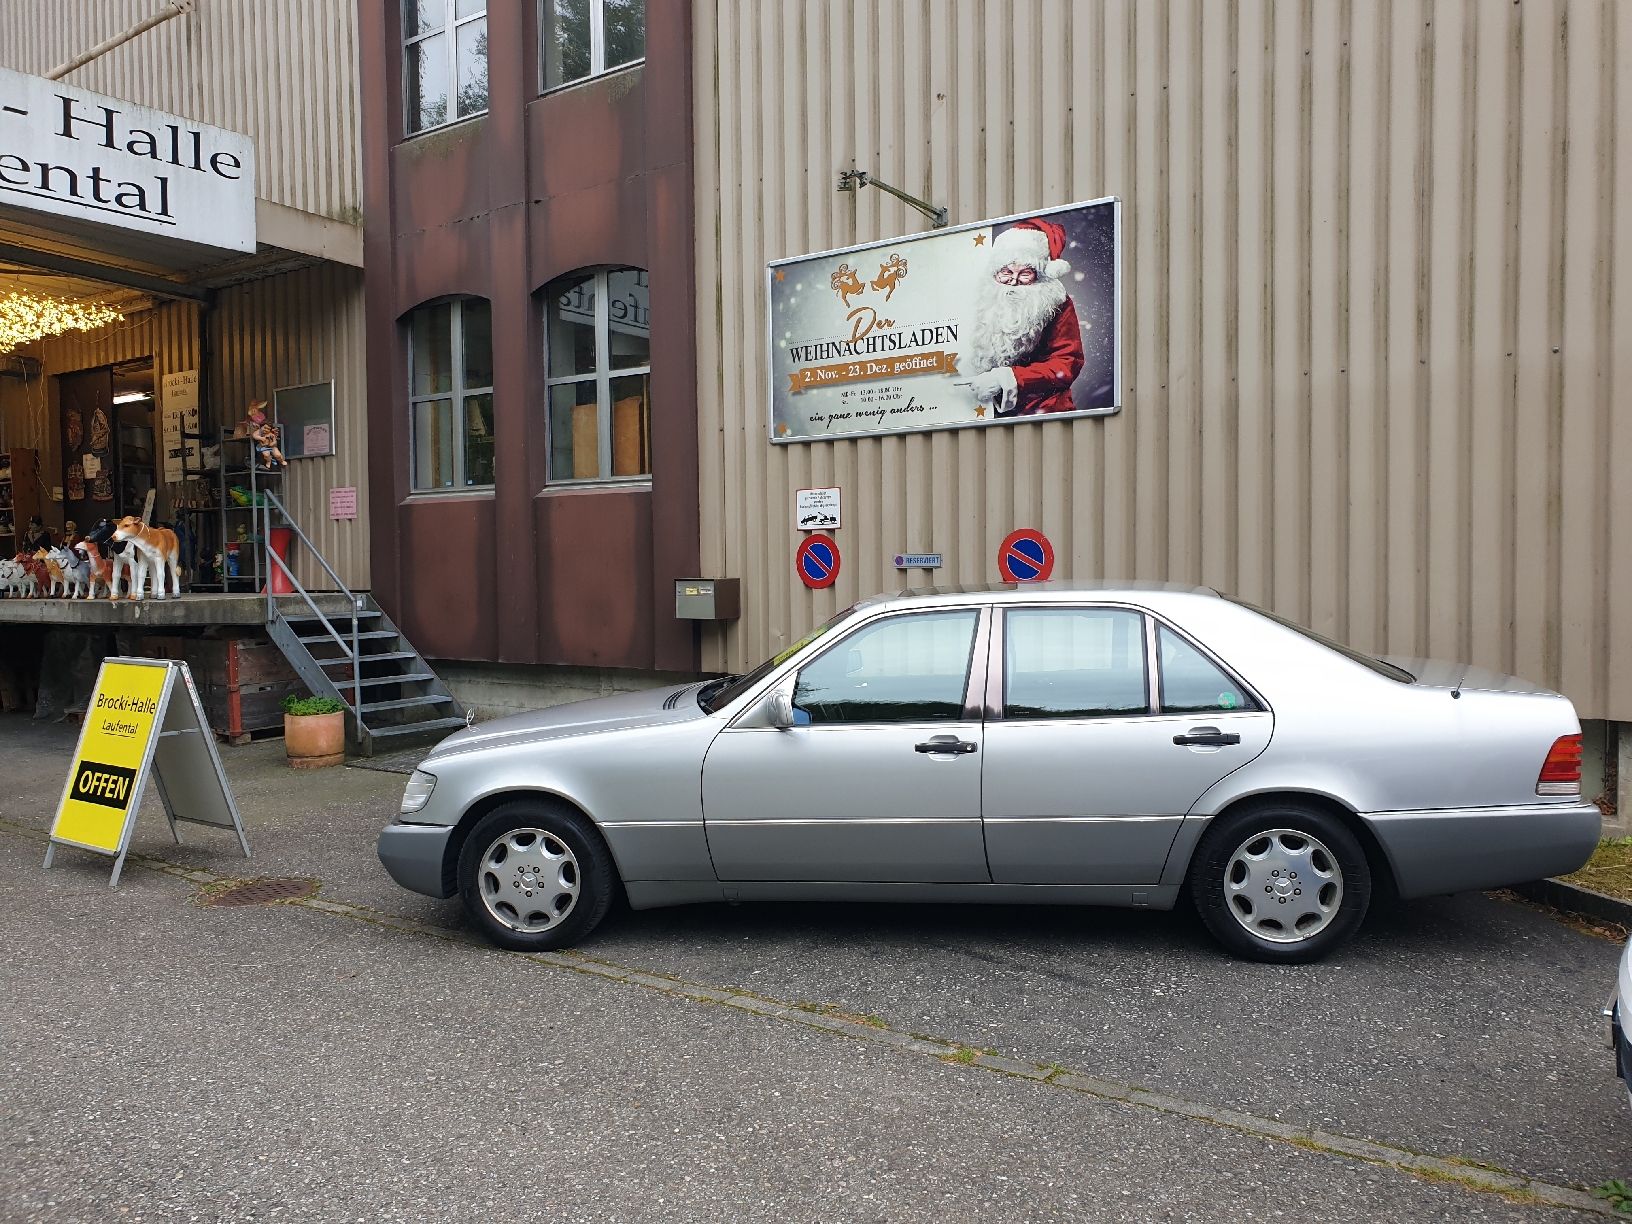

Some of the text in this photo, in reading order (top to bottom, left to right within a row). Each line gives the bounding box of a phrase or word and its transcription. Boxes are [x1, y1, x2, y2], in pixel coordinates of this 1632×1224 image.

[54, 94, 241, 180] Halle
[846, 306, 896, 344] Der
[789, 324, 959, 364] WEIHNACHTSLADEN
[804, 370, 814, 382] 2.
[816, 367, 839, 381] Nov.
[848, 364, 863, 377] 23.
[867, 362, 891, 375] Dez.
[894, 355, 938, 373] geöffnet
[809, 412, 825, 422] ein
[855, 406, 888, 425] wenig
[890, 396, 925, 415] anders
[905, 556, 939, 564] RESERVIERT
[97, 693, 155, 714] Brocki-Halle
[101, 718, 139, 734] Laufental
[79, 770, 129, 800] OFFEN
